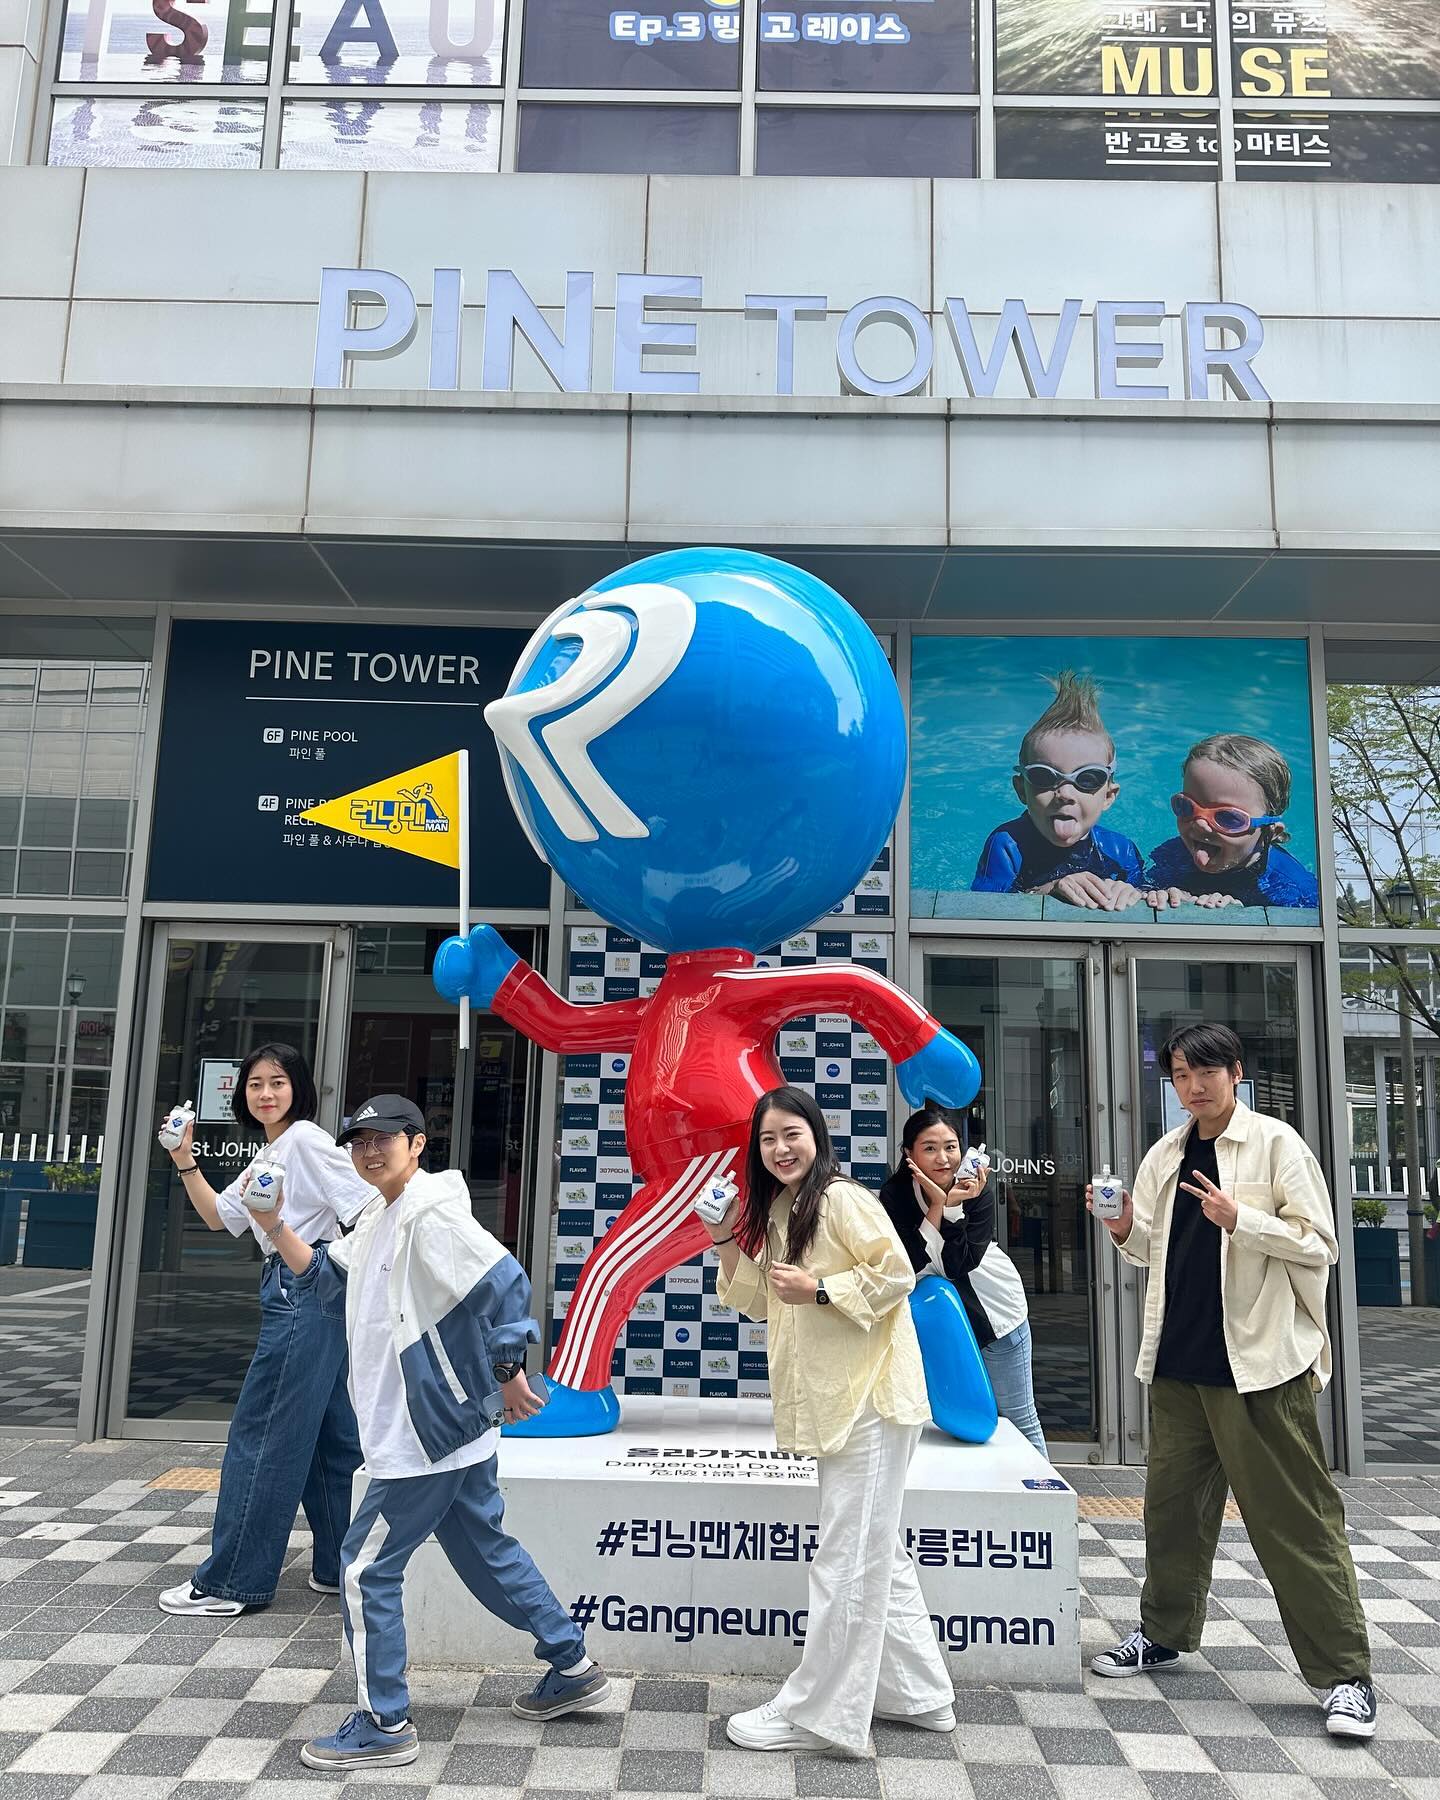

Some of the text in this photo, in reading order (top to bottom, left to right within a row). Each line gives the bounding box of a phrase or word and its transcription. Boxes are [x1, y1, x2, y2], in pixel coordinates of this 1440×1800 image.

[612, 14, 702, 42] Ep.3
[806, 15, 906, 41] 레이스
[1271, 12, 1327, 35] 뮤즈
[1101, 46, 1332, 97] MUSE
[1105, 131, 1132, 154] 반
[1136, 132, 1191, 154] 고흐
[1247, 133, 1331, 156] 마티스
[312, 267, 1273, 402] PINE TOWER
[249, 649, 480, 685] PINE TOWER
[265, 730, 358, 743] 6F PINE POOL
[289, 747, 326, 761] 파인 풀
[260, 798, 277, 810] 4F
[285, 798, 315, 809] PINE
[350, 799, 427, 834] 런닝맨
[425, 823, 448, 832] MAN
[282, 833, 306, 847] 파인
[308, 834, 321, 847] 풀
[322, 834, 332, 846] &
[191, 1141, 268, 1158] St.JOHN
[605, 1460, 741, 1470] Dangerous!
[748, 1462, 780, 1471] Do
